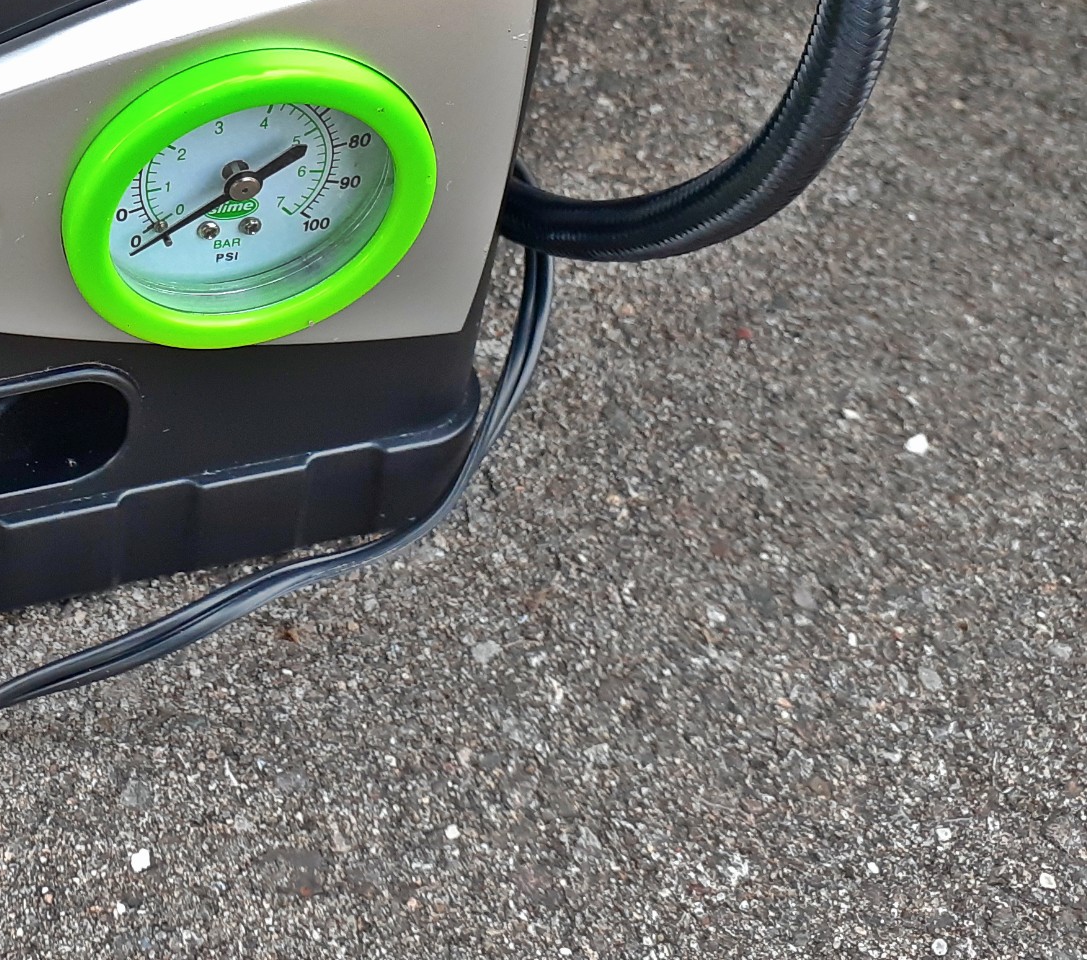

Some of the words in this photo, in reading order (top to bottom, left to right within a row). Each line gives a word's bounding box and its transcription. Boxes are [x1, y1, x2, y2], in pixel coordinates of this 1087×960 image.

[215, 121, 223, 134] 3
[259, 117, 268, 129] 4
[292, 136, 301, 146] 5
[348, 133, 371, 149] 80
[177, 148, 187, 160] 2
[297, 166, 306, 177] 6
[165, 181, 171, 192] 1
[339, 175, 361, 189] 90
[208, 200, 254, 214] slime
[277, 196, 285, 207] 7
[116, 208, 128, 222] 0
[176, 204, 184, 214] 0
[303, 217, 330, 232] 100
[130, 235, 142, 247] 0
[213, 238, 240, 249] BAR
[215, 252, 238, 263] PSI
